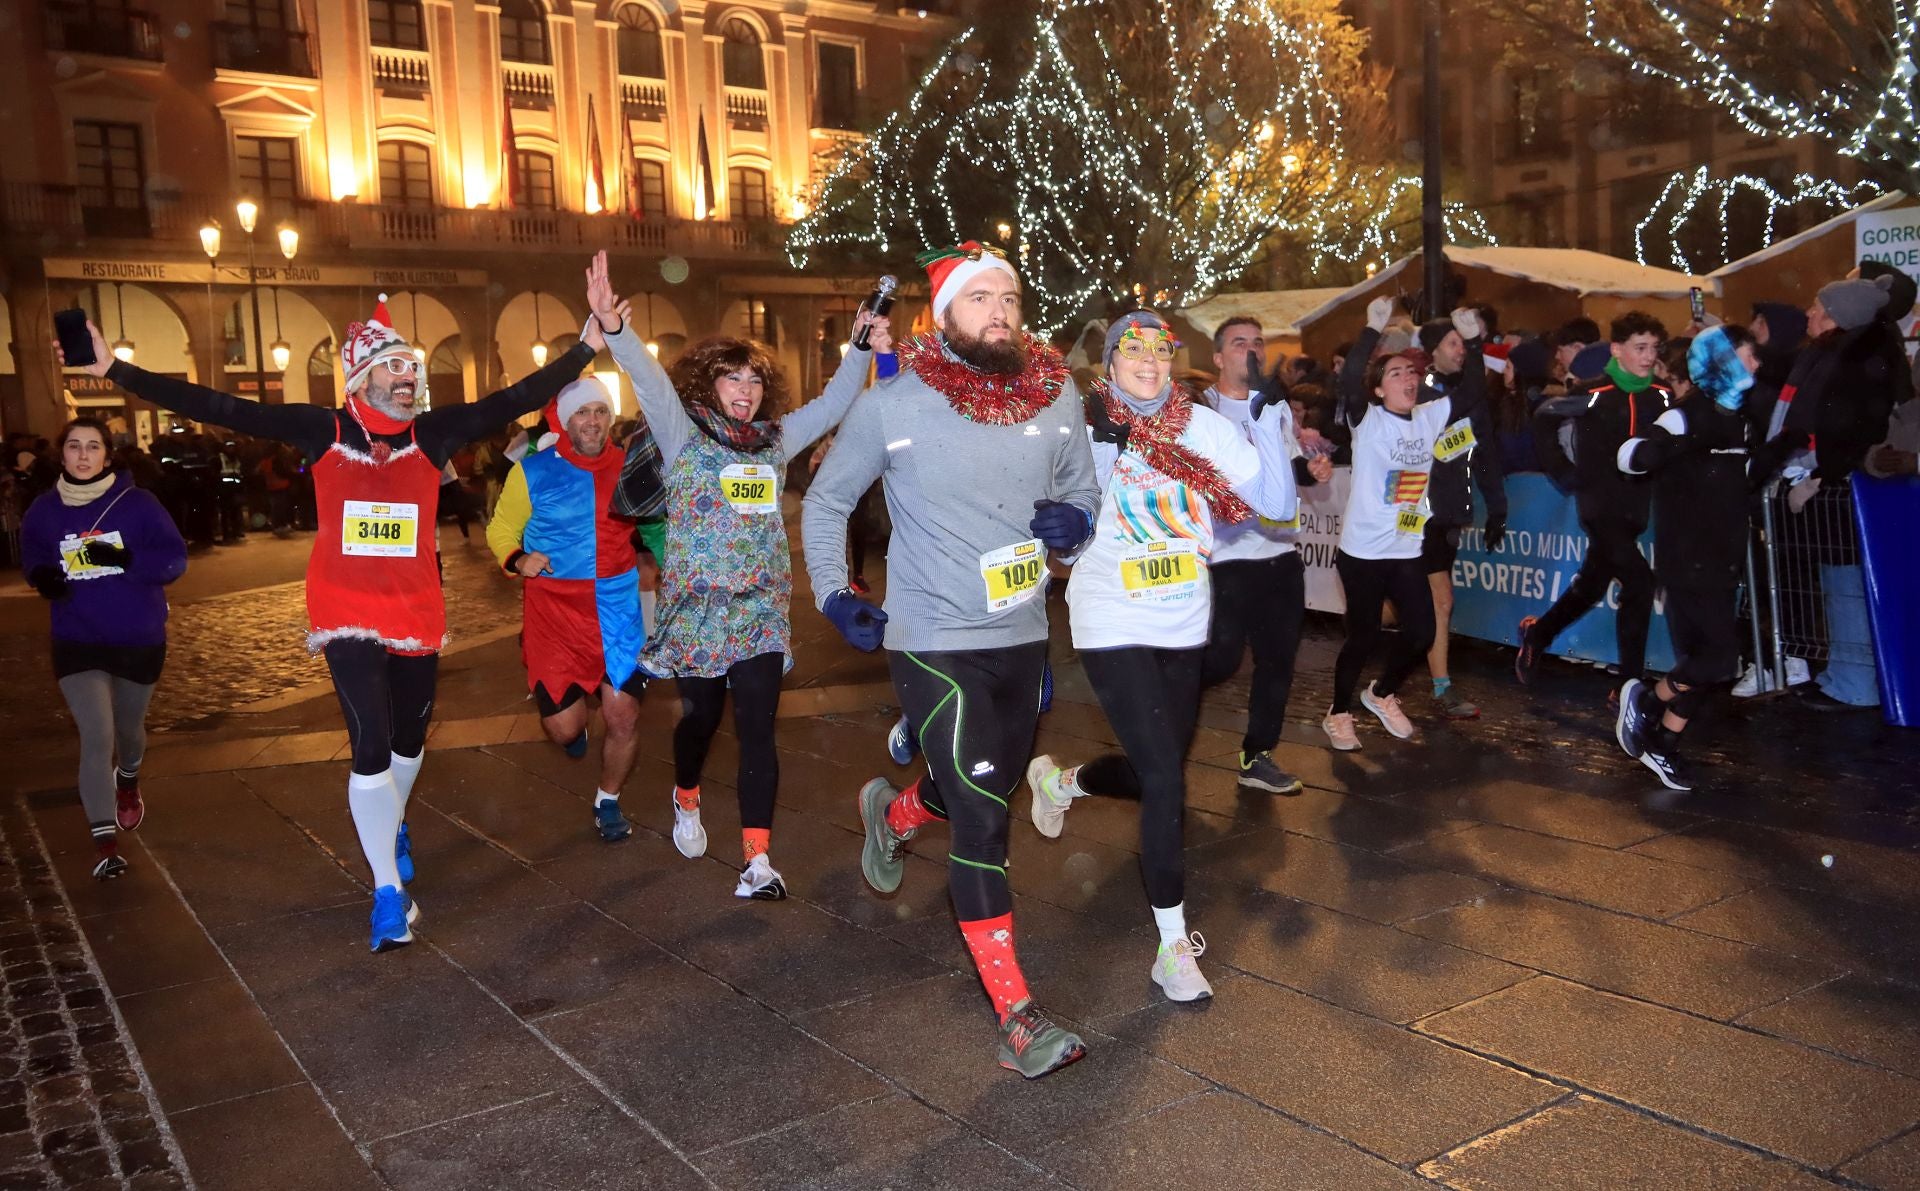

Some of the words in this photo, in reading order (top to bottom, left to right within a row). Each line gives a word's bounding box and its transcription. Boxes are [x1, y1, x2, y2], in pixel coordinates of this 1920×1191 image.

[82, 261, 166, 279] RESTAURANTE
[285, 266, 320, 281] BRAVO
[69, 378, 113, 390] BRAVO
[731, 482, 765, 499] 3502
[358, 521, 401, 540] 3448
[1300, 513, 1321, 535] PAL
[1326, 514, 1341, 536] DE
[1136, 555, 1181, 581] 1001
[1452, 559, 1546, 601] EPORTES
